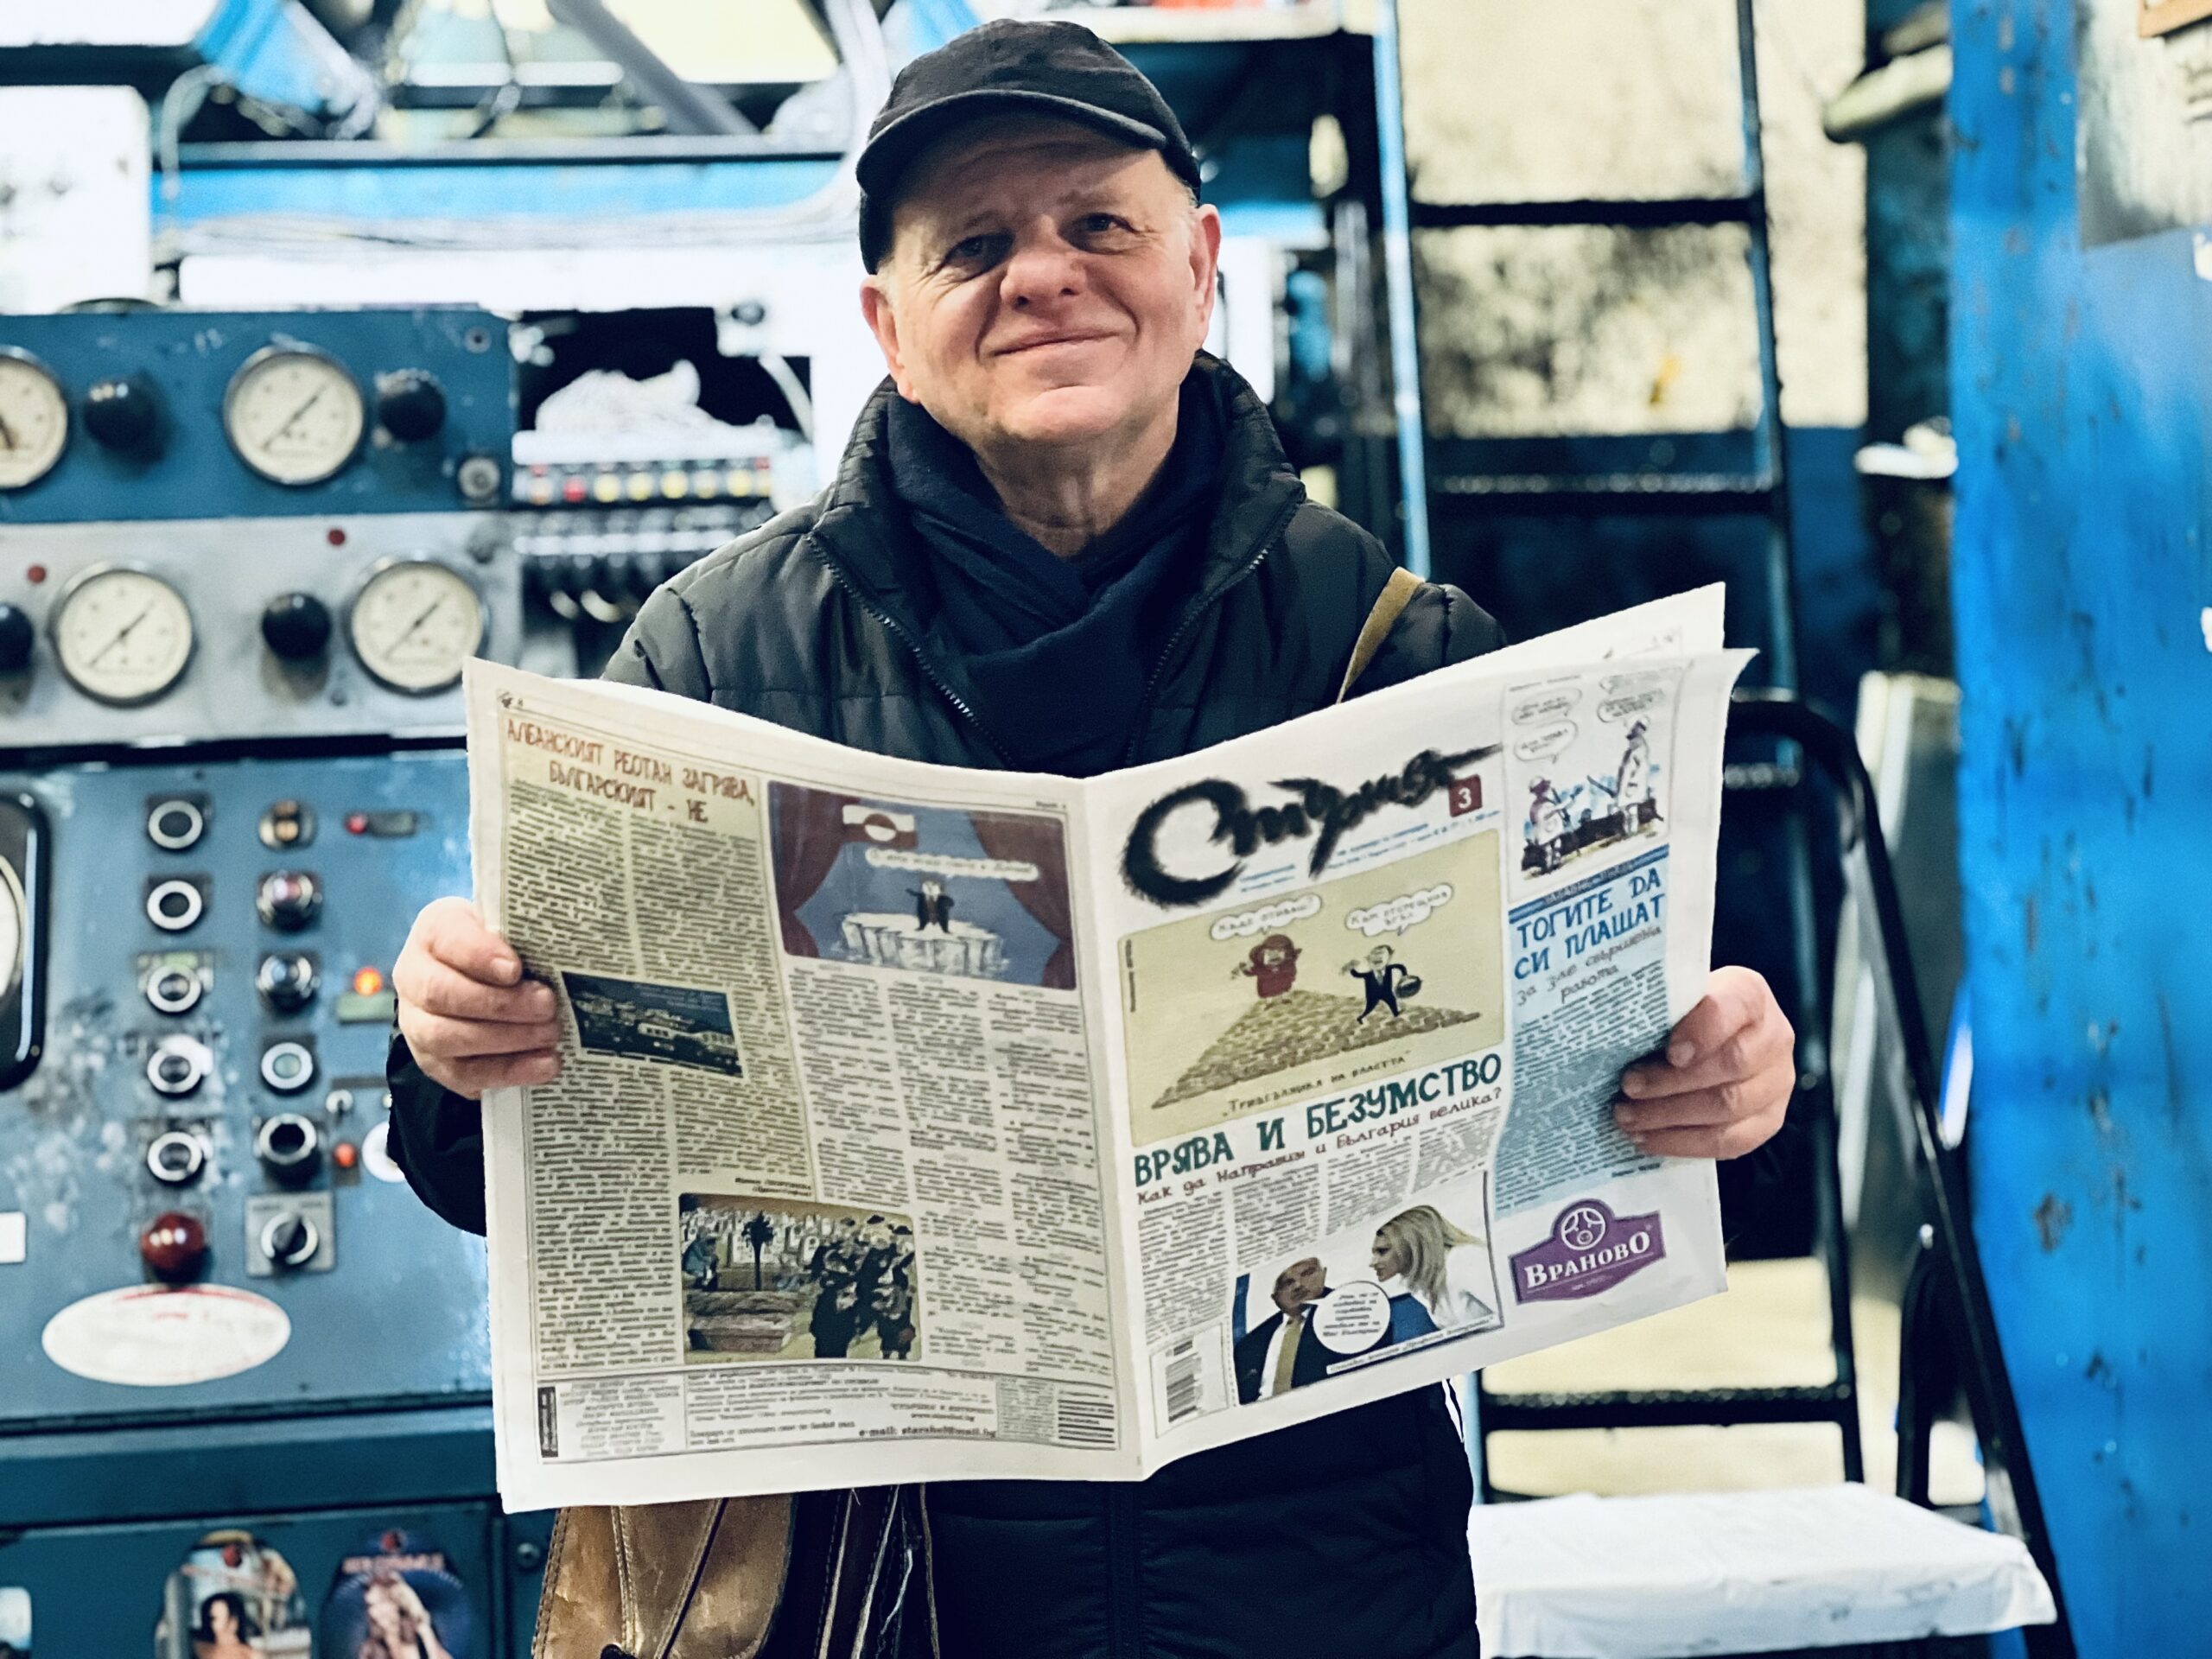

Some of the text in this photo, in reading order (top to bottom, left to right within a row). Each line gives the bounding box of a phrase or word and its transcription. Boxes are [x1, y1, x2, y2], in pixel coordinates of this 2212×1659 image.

[613, 748, 673, 785] РЕОТАН
[686, 798, 709, 823] НЕ
[1458, 787, 1472, 809] 3
[1517, 887, 1613, 949] ТОГИТЕ
[1629, 868, 1661, 899] ДА
[1515, 947, 1550, 980] СИ
[1134, 1053, 1502, 1187] ВРЯВА И БЕЗУМСТВО
[1138, 1186, 1174, 1206] Как
[1184, 1177, 1206, 1196] да
[1316, 1142, 1327, 1154] и
[1337, 1114, 1421, 1149] България
[1430, 1087, 1503, 1122] велика?
